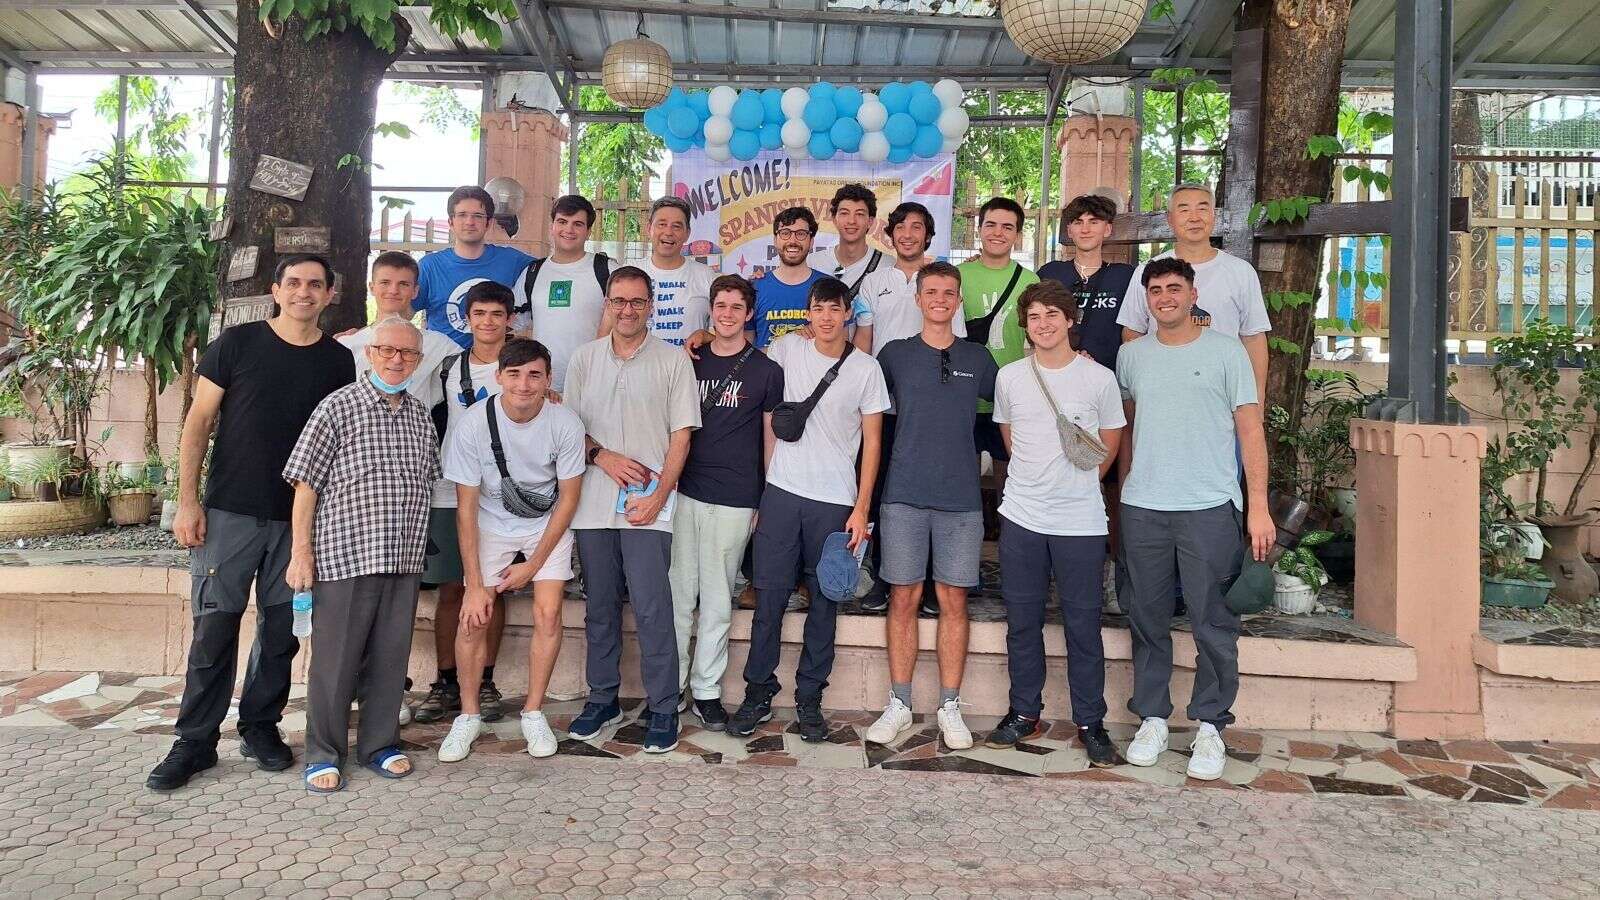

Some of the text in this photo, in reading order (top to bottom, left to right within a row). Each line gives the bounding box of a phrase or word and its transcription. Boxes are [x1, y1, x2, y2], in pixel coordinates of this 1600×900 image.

[685, 157, 791, 220] WELCOME!
[657, 307, 685, 316] WALK
[766, 309, 809, 321] ALCORC
[655, 321, 683, 330] SLEEP
